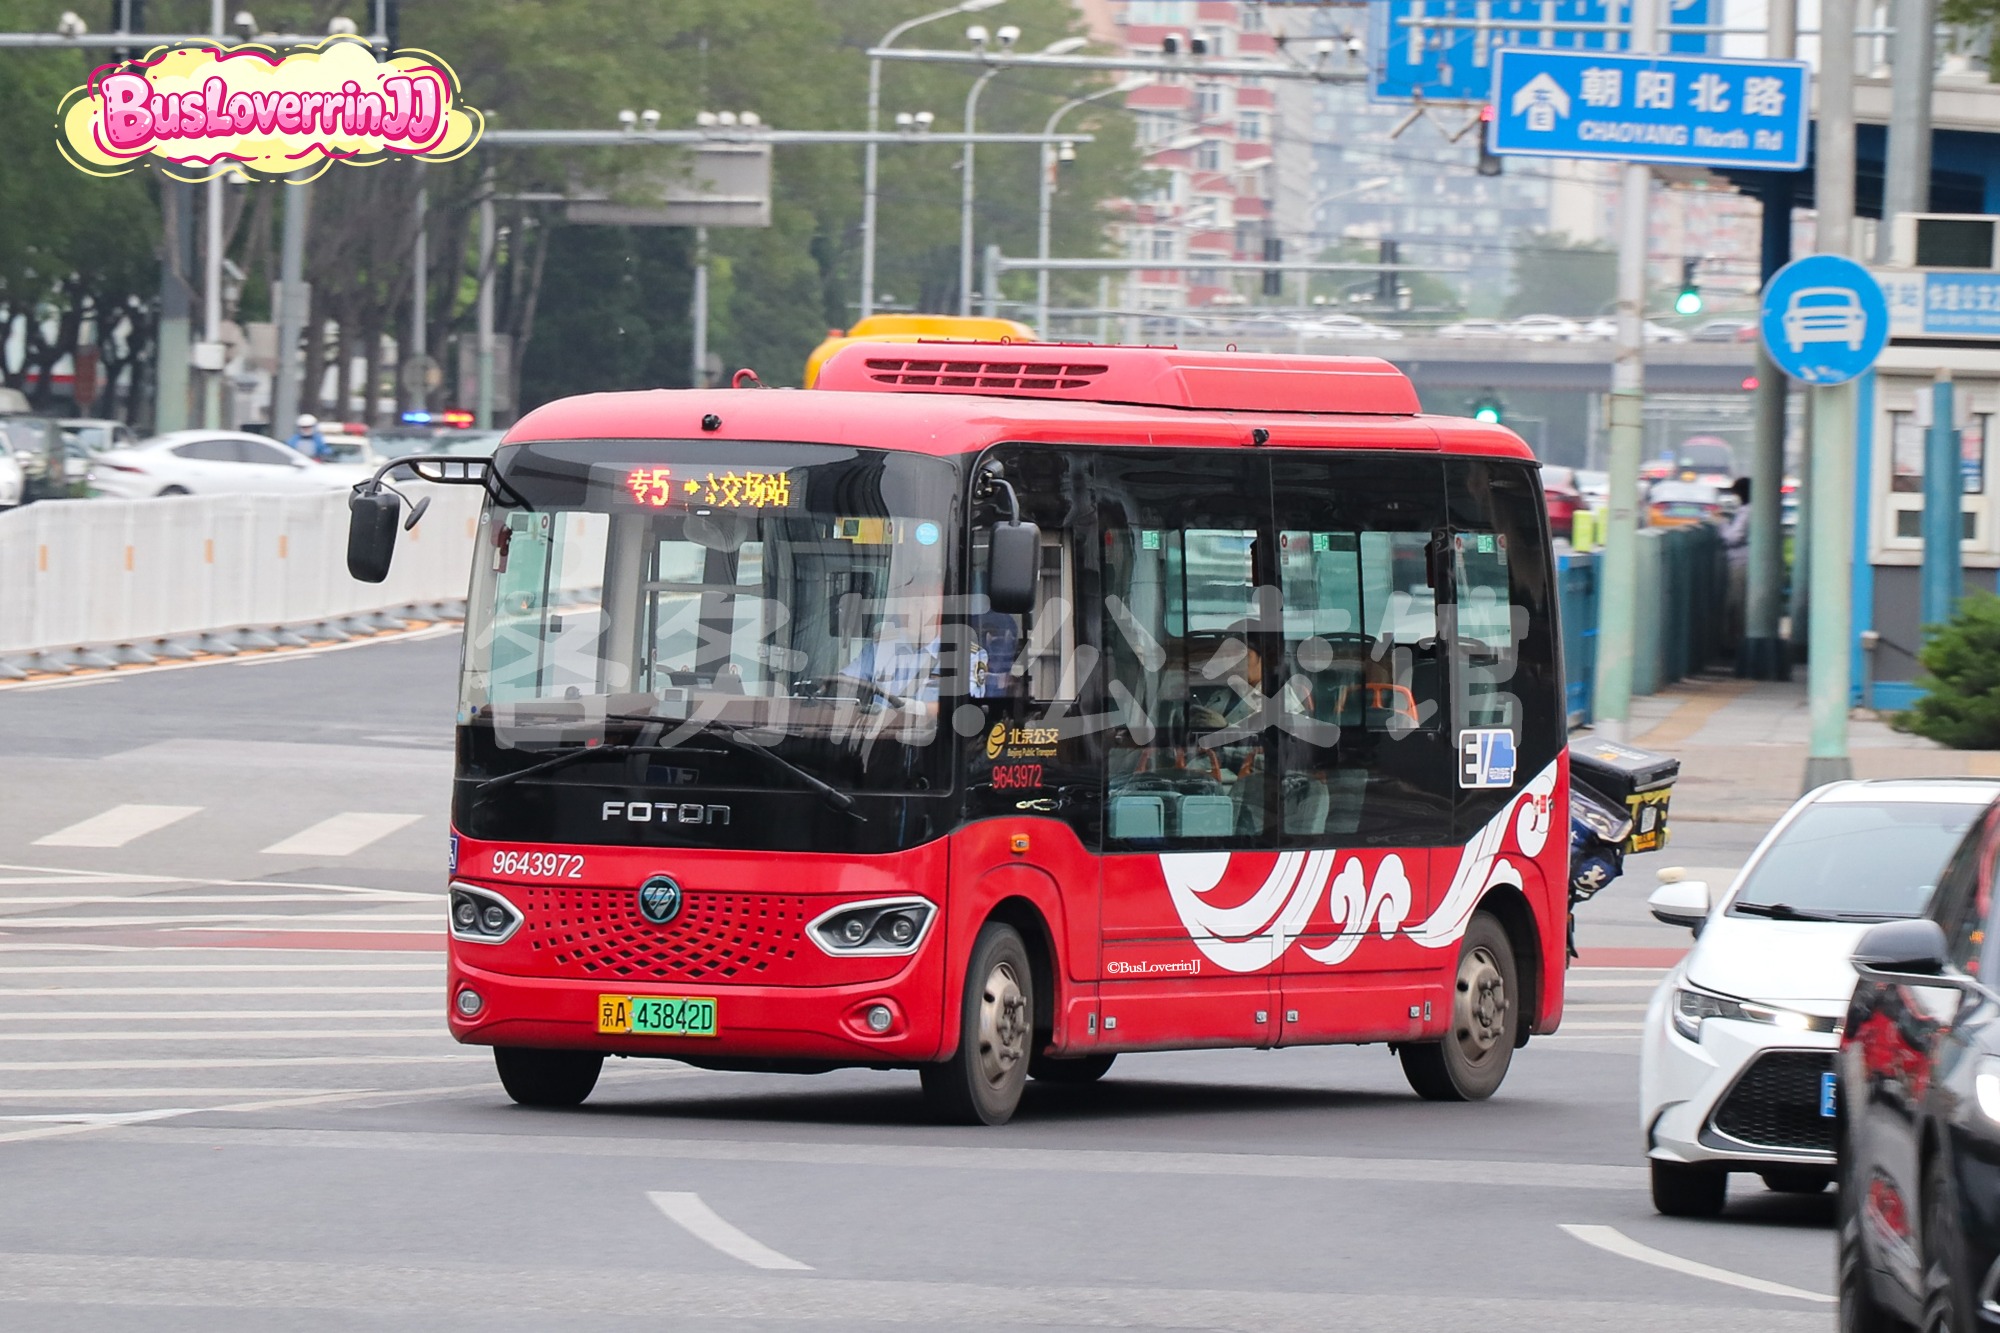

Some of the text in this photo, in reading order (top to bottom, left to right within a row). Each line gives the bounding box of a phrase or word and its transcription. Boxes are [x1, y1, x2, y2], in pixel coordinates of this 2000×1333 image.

[1579, 67, 1785, 117] 朝阳北路
[1578, 121, 1783, 150] CHAOYANG North Rd
[628, 469, 671, 506] 专5
[1008, 728, 1059, 745] 北京公交
[992, 765, 1042, 788] 9643972
[602, 801, 731, 825] FOTON
[492, 850, 585, 878] 9643972
